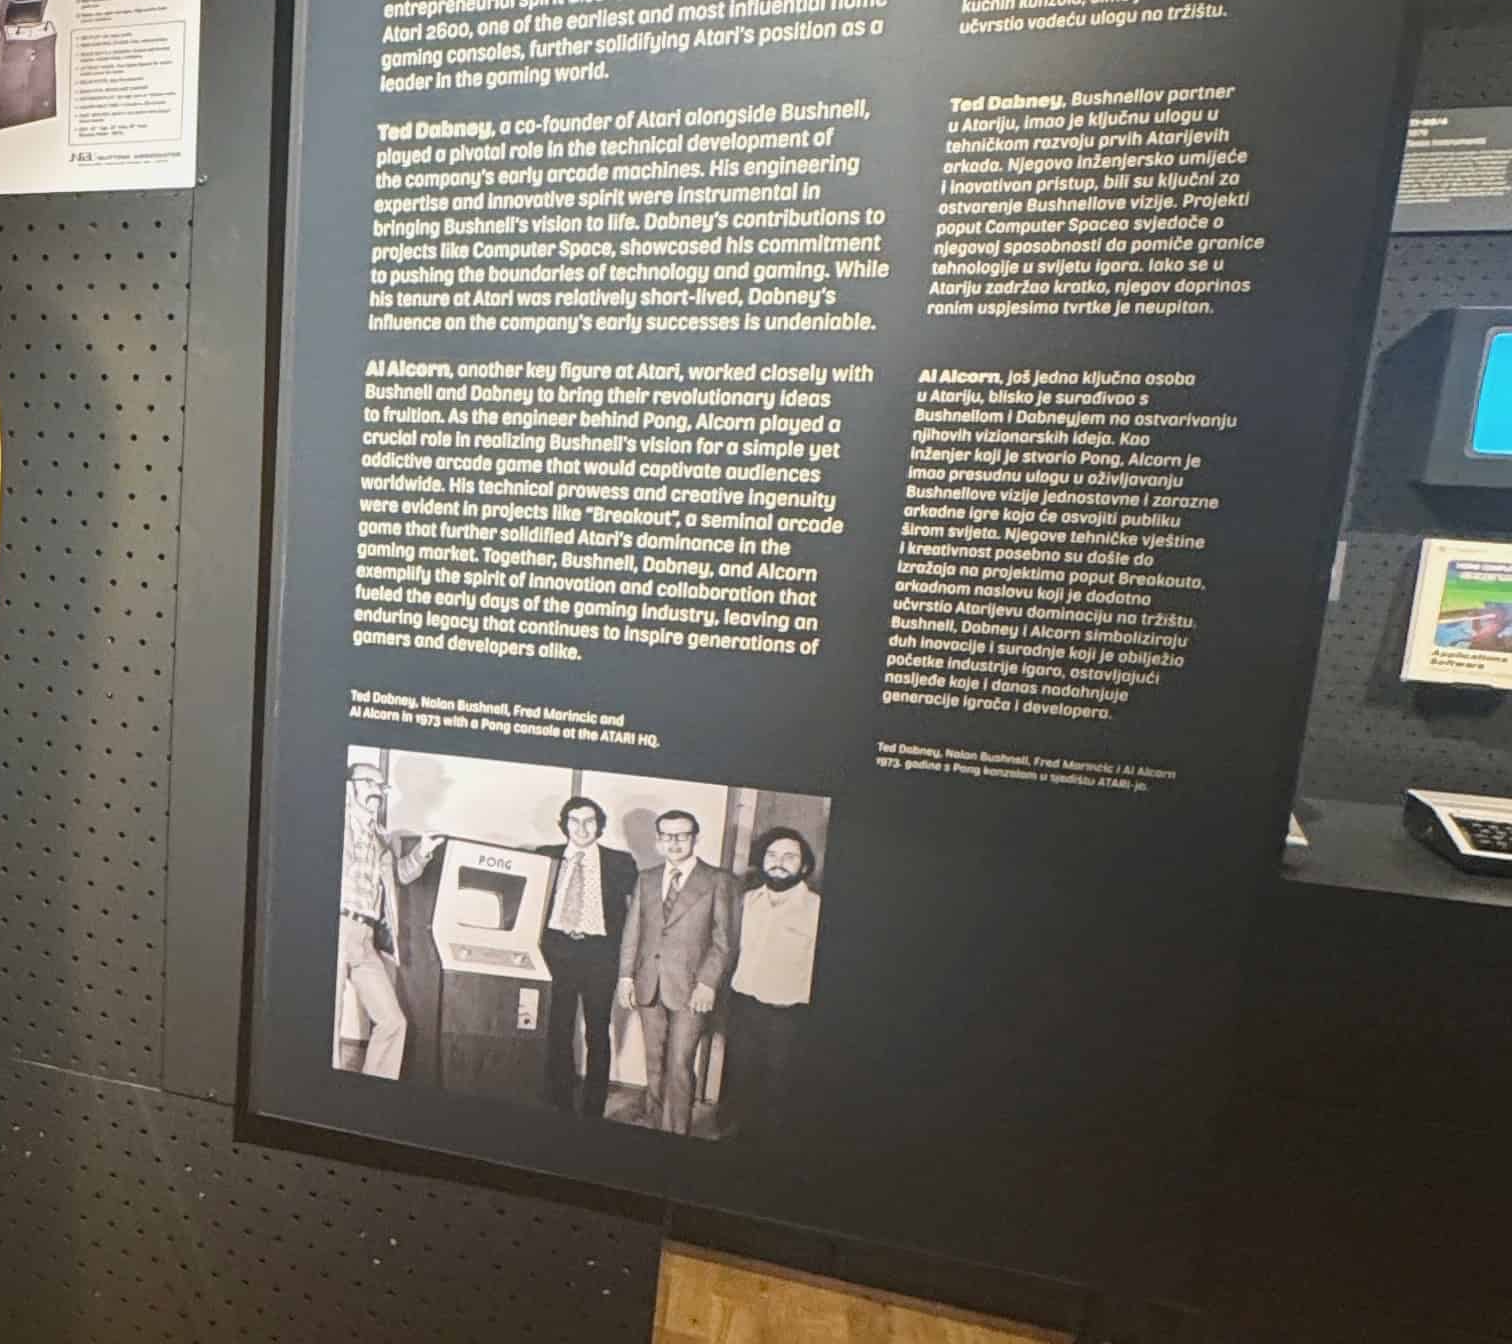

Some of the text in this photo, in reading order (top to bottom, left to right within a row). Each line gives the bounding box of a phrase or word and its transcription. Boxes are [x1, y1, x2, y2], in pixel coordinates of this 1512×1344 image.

[376, 121, 413, 141] Ted
[414, 119, 496, 140] Dabney,
[514, 112, 612, 134] co-founder
[614, 109, 635, 130] of
[635, 108, 681, 128] Atari
[684, 103, 776, 128] alongside
[780, 98, 870, 121] Bushnell,
[371, 233, 882, 263] projects like Computer Space, showcased his commitment
[364, 359, 874, 385] Al Alcorn, another key figure at Atari, worked closely with
[352, 629, 582, 660] gamers and developers alike.
